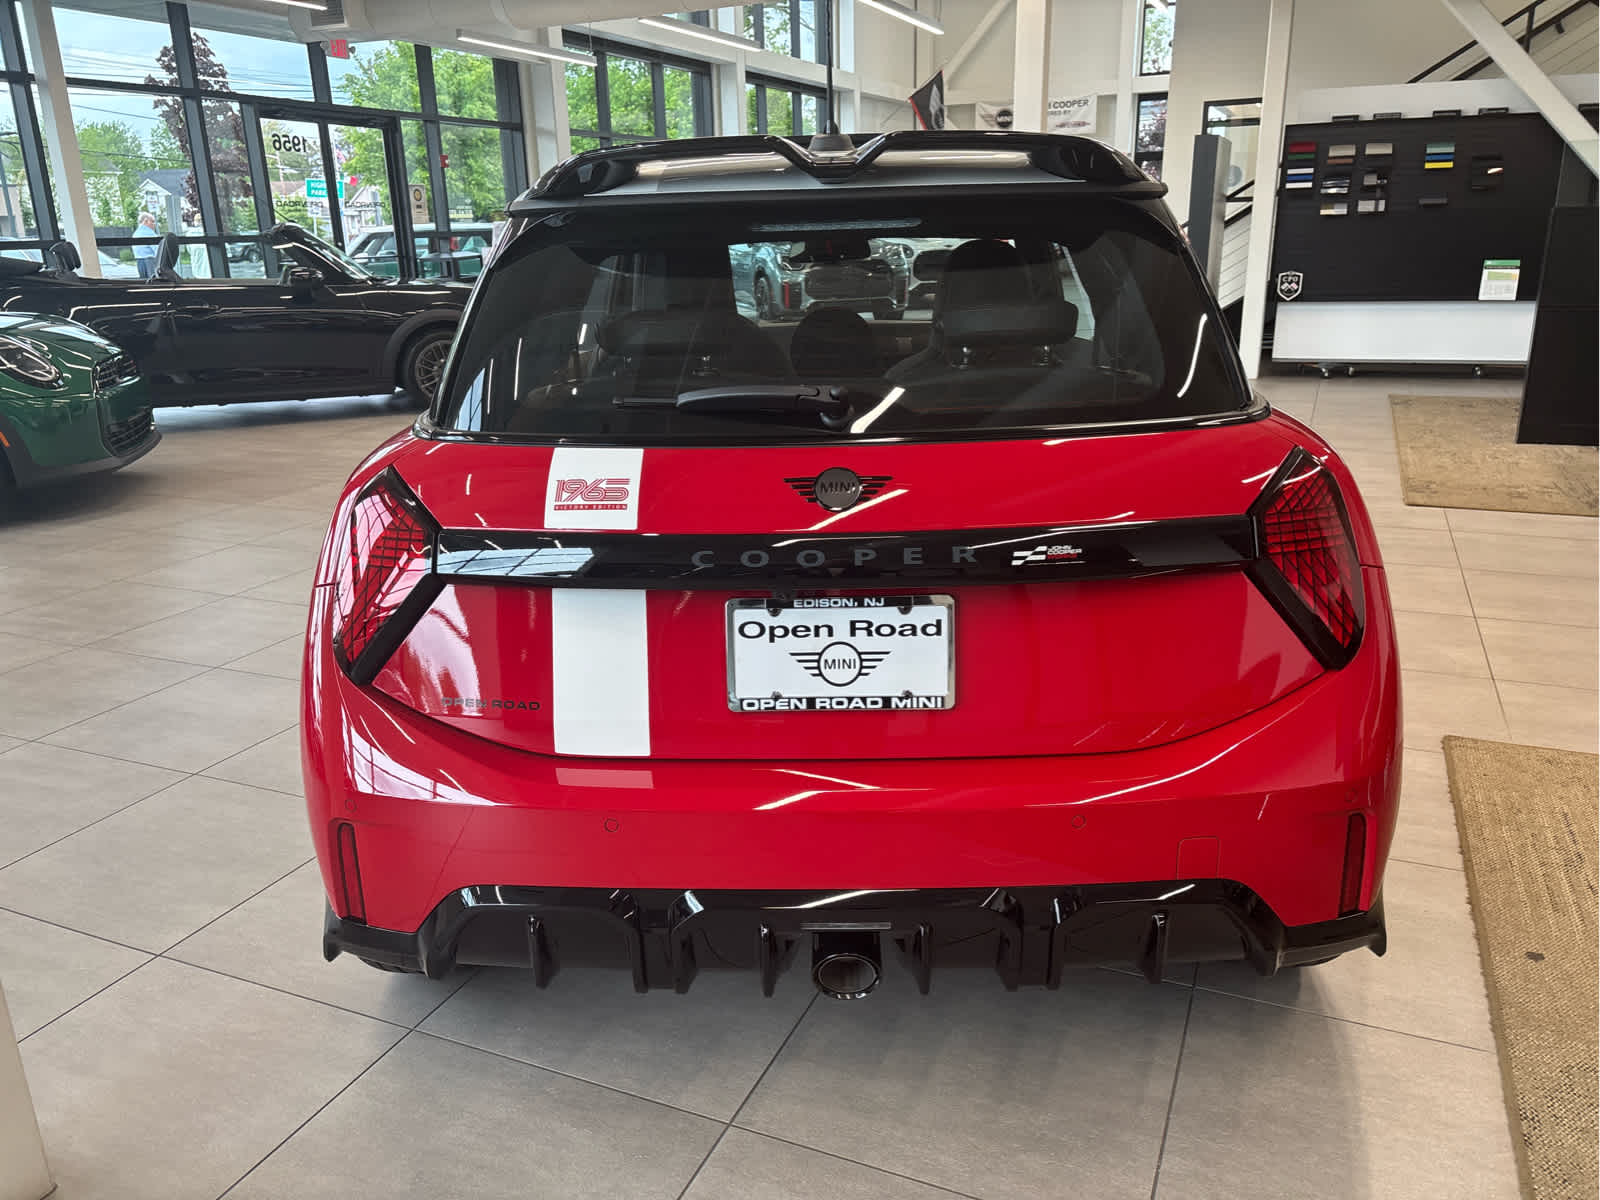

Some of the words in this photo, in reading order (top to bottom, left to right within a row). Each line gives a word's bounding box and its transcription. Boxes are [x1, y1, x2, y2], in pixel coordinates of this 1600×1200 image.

[1053, 99, 1089, 109] COOPER
[554, 478, 631, 502] 1965
[820, 480, 857, 495] MINI
[691, 546, 977, 568] COOPER
[793, 598, 858, 608] EDISON,
[864, 597, 885, 607] NJ
[738, 621, 834, 644] Open
[849, 619, 942, 638] Road
[823, 658, 857, 670] MINI
[441, 697, 487, 708] OPEN
[491, 699, 541, 711] ROAD
[742, 698, 807, 711] OPEN
[815, 697, 882, 709] ROAD
[891, 696, 942, 709] MINI
